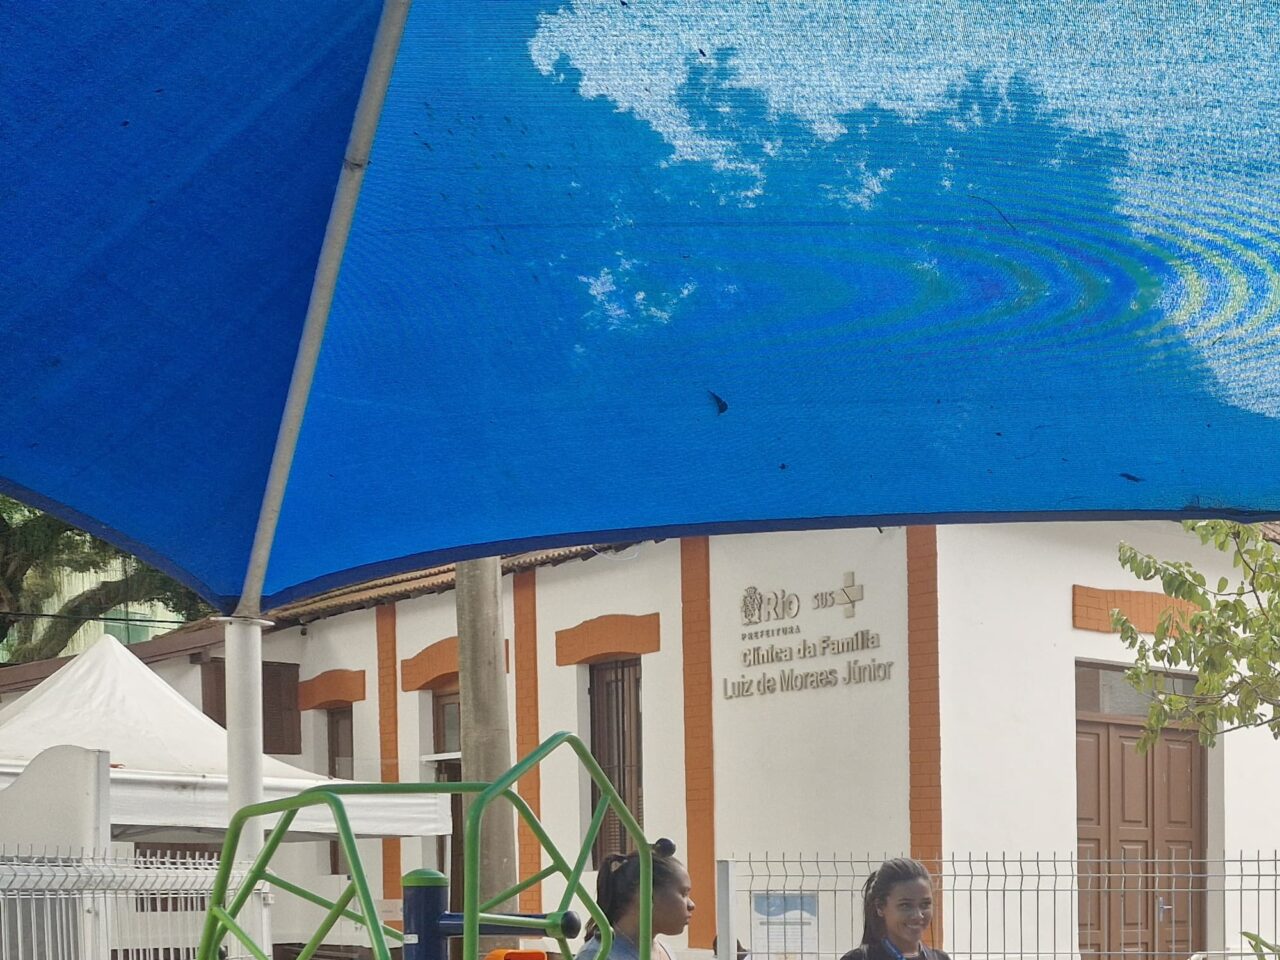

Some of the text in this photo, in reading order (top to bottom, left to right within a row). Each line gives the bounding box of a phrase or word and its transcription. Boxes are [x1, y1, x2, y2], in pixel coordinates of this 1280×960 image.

[812, 590, 836, 610] SUS
[741, 625, 801, 641] PREFEITURA
[742, 629, 881, 668] Clínica da Família
[723, 658, 894, 700] Luiz de Moraes Júnior
